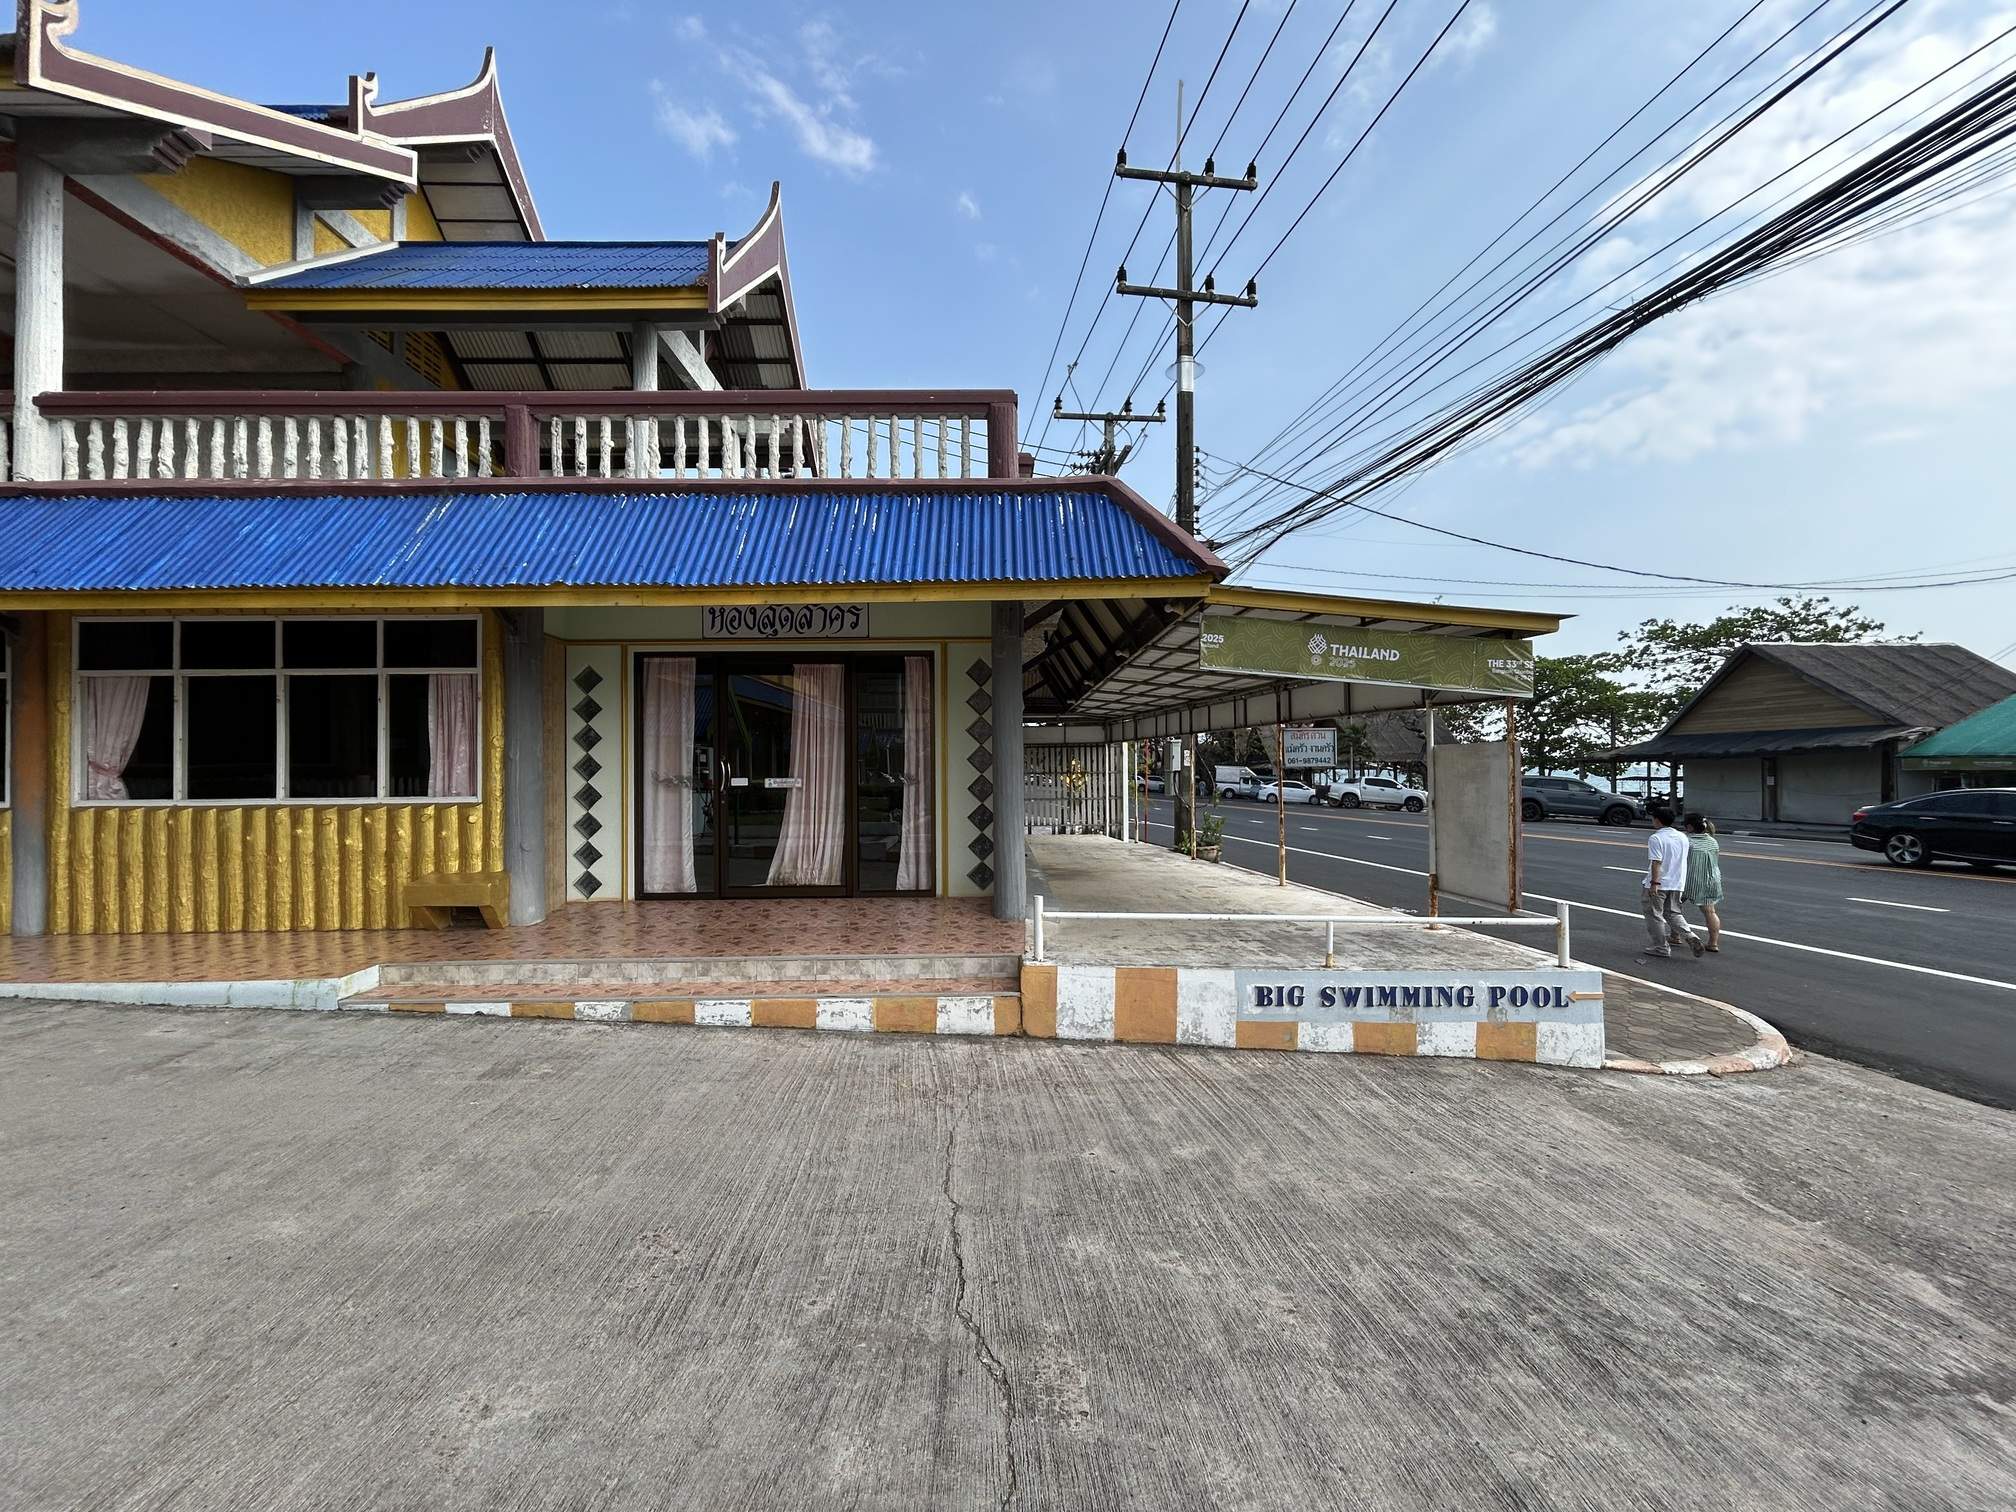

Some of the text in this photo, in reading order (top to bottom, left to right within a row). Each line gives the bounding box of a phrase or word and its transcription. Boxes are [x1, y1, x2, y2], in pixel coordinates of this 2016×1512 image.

[1200, 633, 1225, 643] 2025
[1330, 643, 1401, 662] THAILAND
[1487, 659, 1504, 668] THE
[1254, 985, 1570, 1009] BIG SWIMMING POOL
